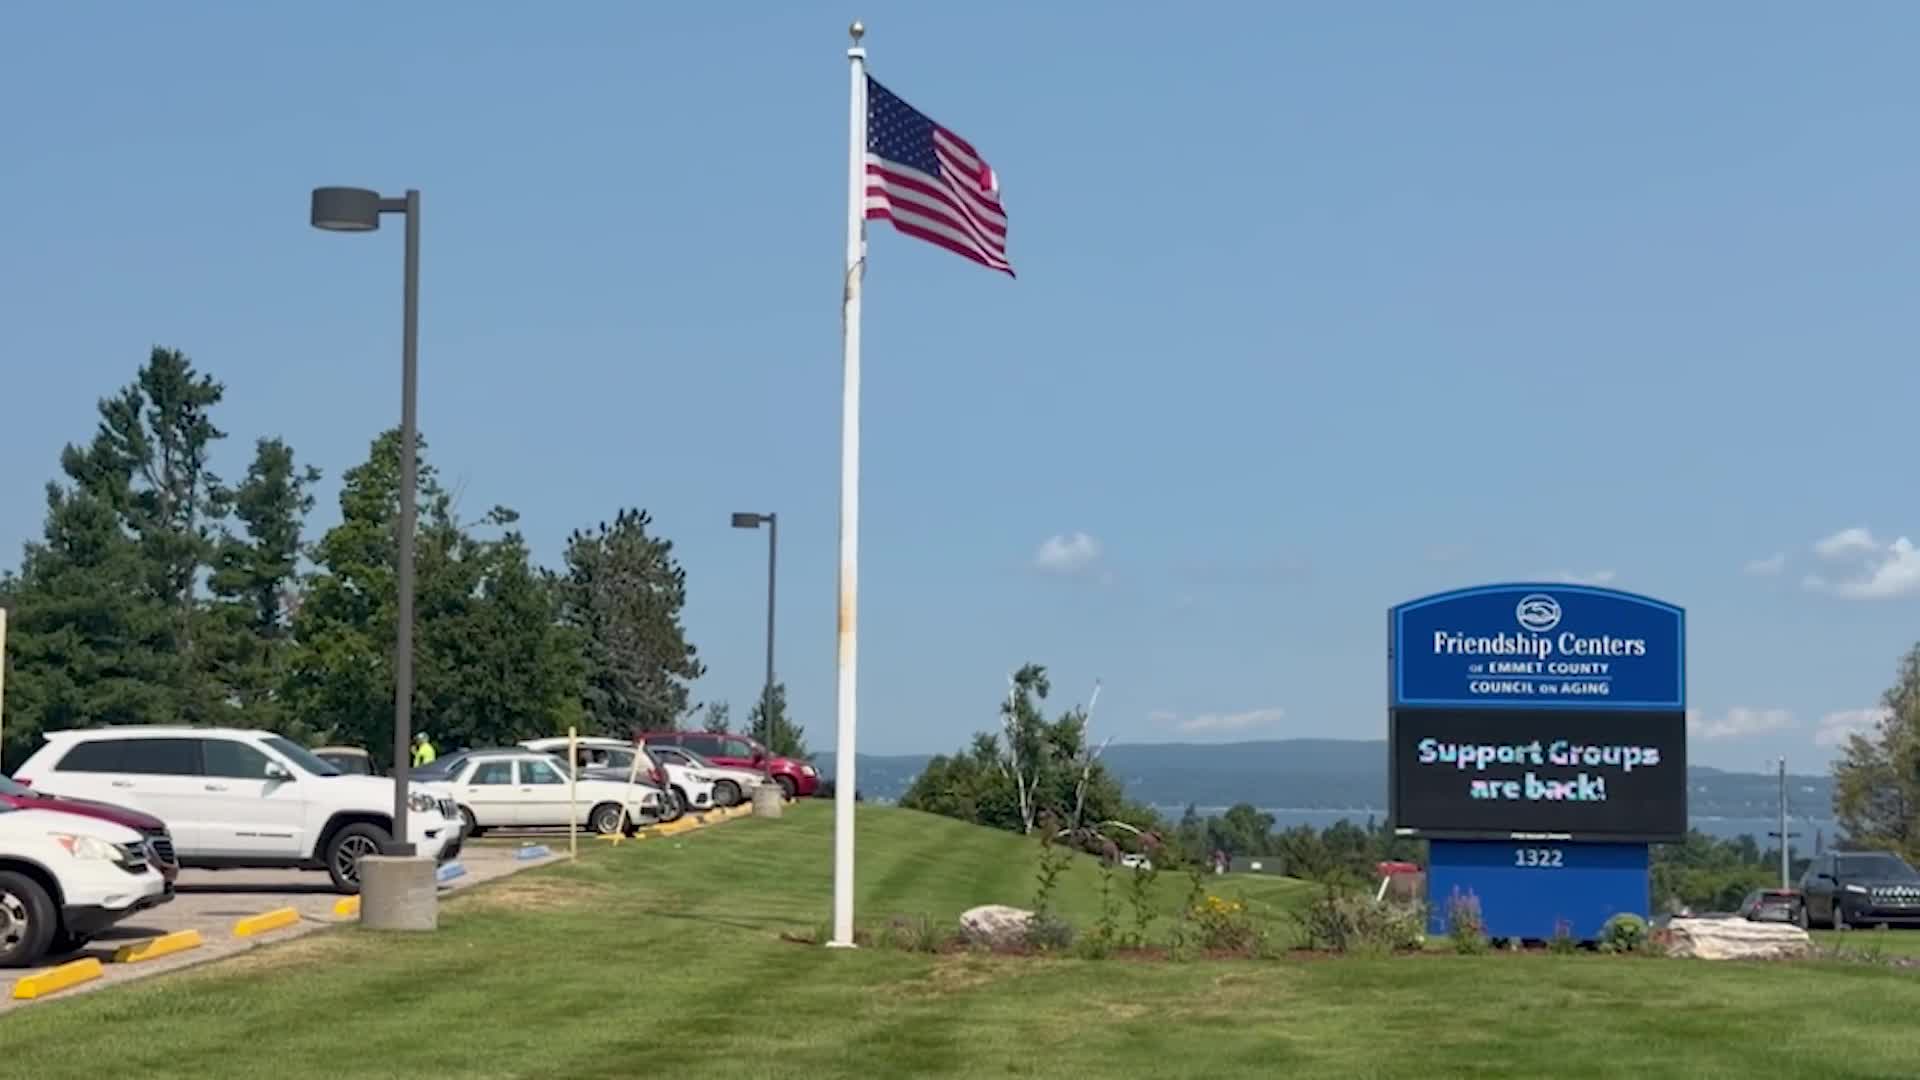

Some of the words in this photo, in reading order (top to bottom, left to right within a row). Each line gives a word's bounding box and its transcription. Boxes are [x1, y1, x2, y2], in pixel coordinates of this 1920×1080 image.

[1433, 631, 1552, 659] Friendship
[1558, 631, 1646, 656] Centers
[1489, 662, 1543, 674] EMMET
[1548, 662, 1609, 675] COUNTY
[1470, 681, 1534, 694] COUNCIL
[1561, 681, 1609, 695] AGING
[1418, 738, 1544, 769] Support
[1549, 740, 1660, 772] Groups
[1470, 780, 1520, 799] are
[1525, 771, 1607, 801] back!
[1515, 849, 1564, 867] 1322
